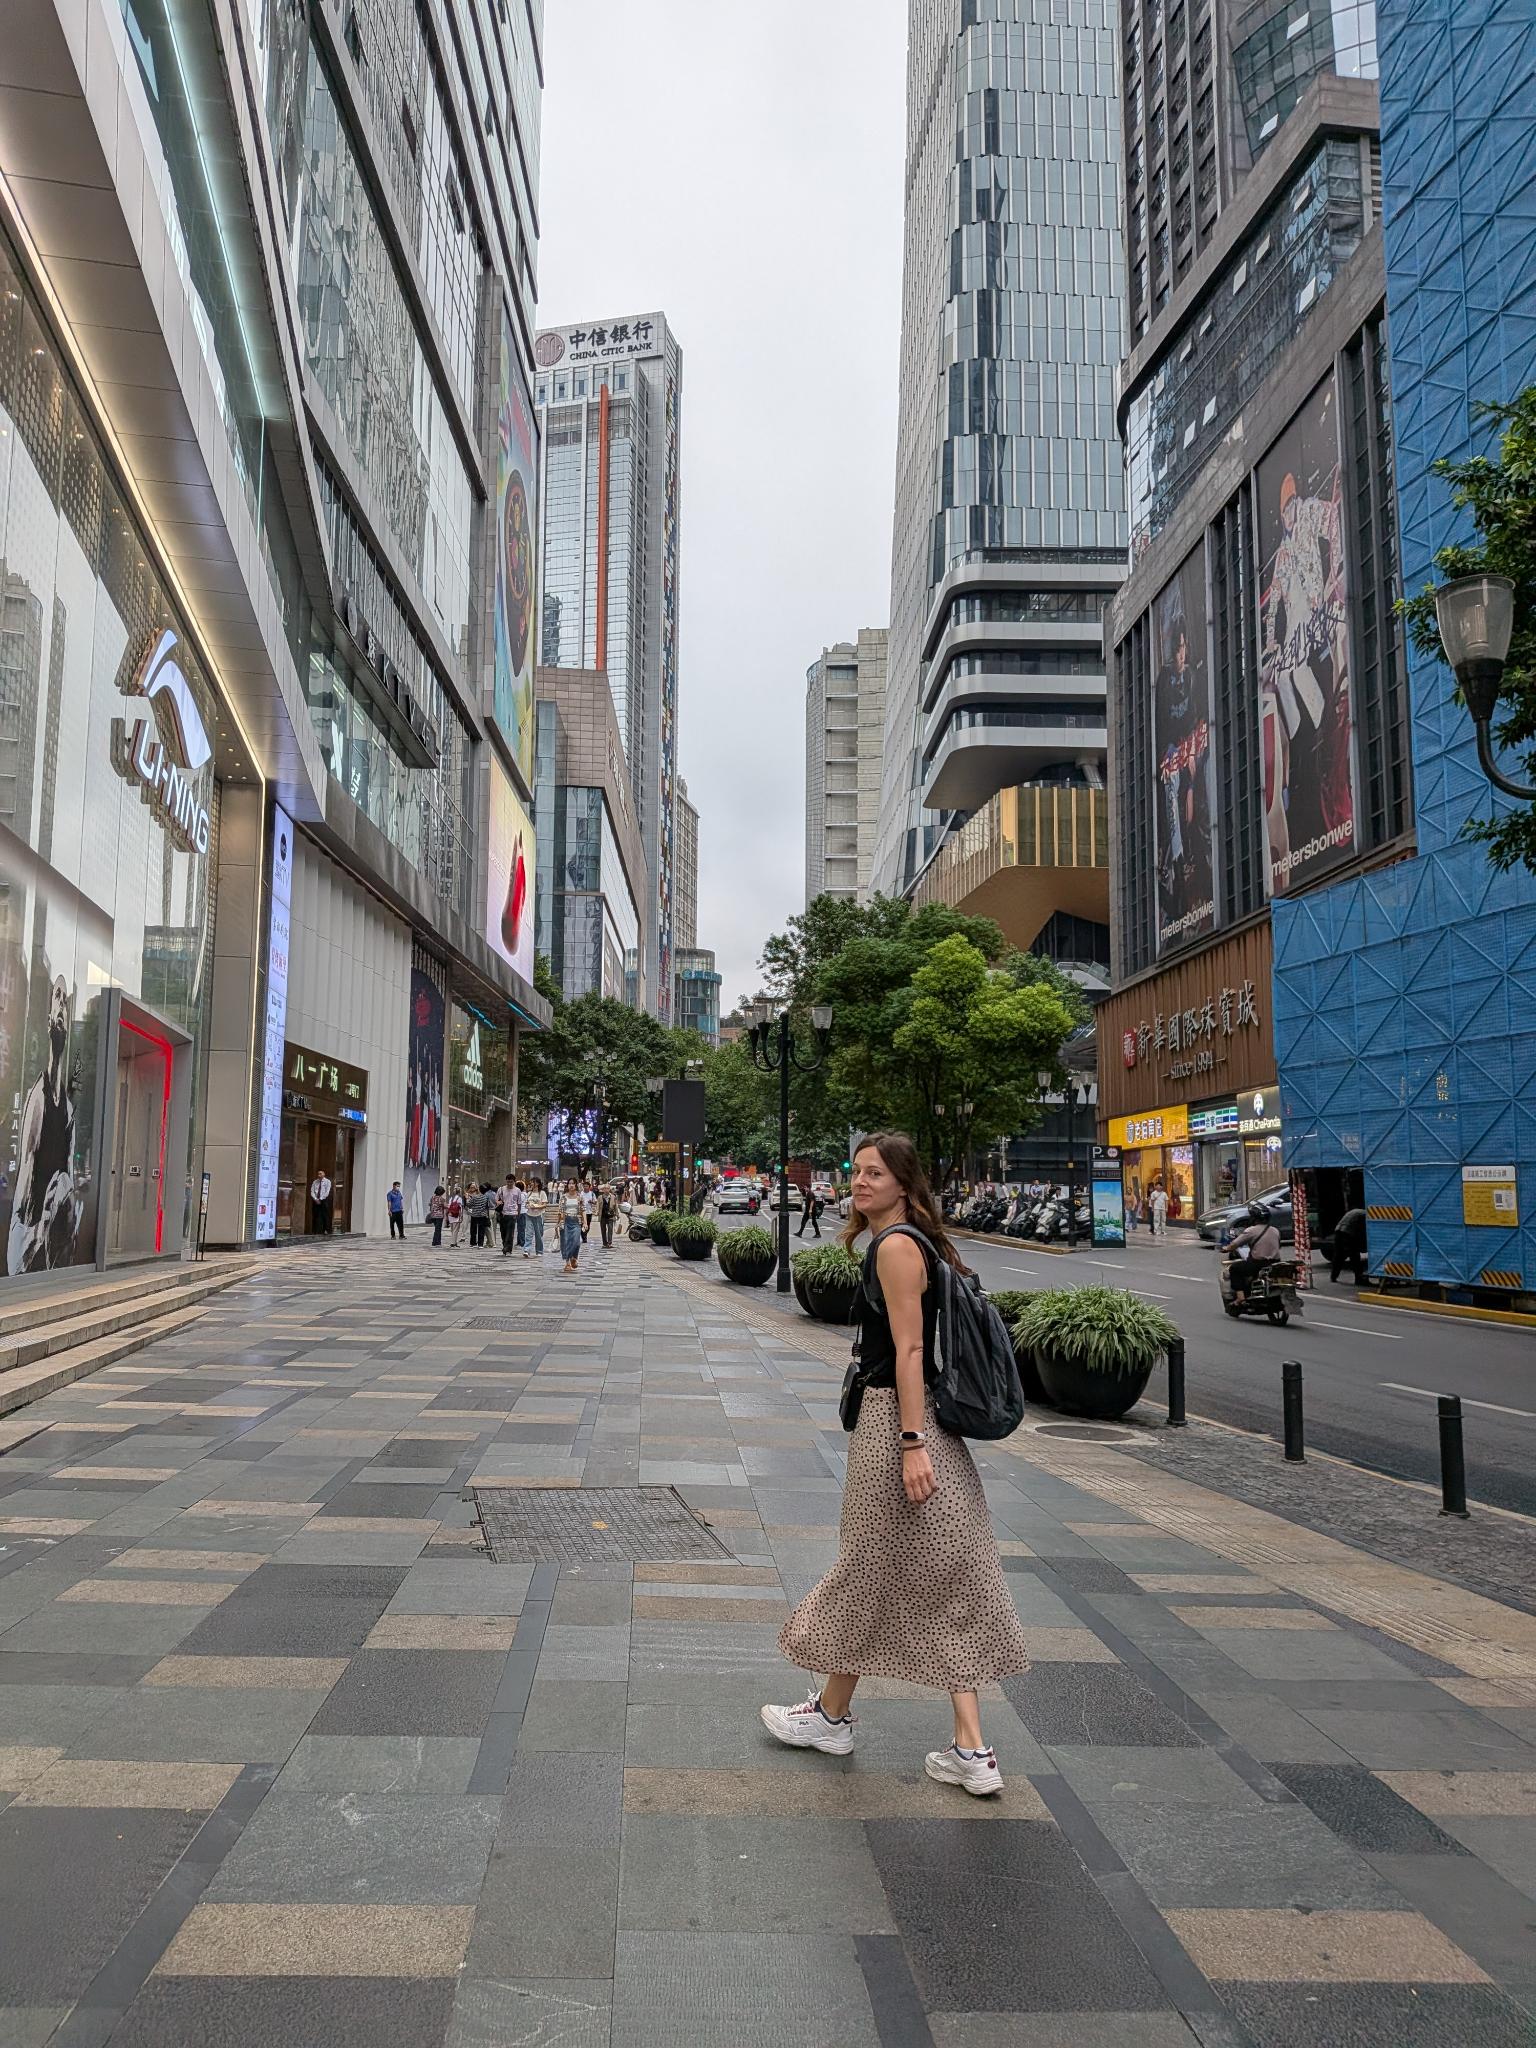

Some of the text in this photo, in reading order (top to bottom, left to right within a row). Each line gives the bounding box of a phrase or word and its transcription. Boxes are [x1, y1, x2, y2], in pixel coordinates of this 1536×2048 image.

[569, 320, 653, 350] 中信银行
[569, 342, 653, 361] CHINA CITIC BANK
[134, 718, 209, 854] LI-NING
[1271, 819, 1353, 877] metersbonwe
[1160, 900, 1214, 942] metersbonwe
[292, 1054, 339, 1092] 八一广场
[463, 1064, 483, 1091] adidas
[1170, 1049, 1214, 1080] since 1994
